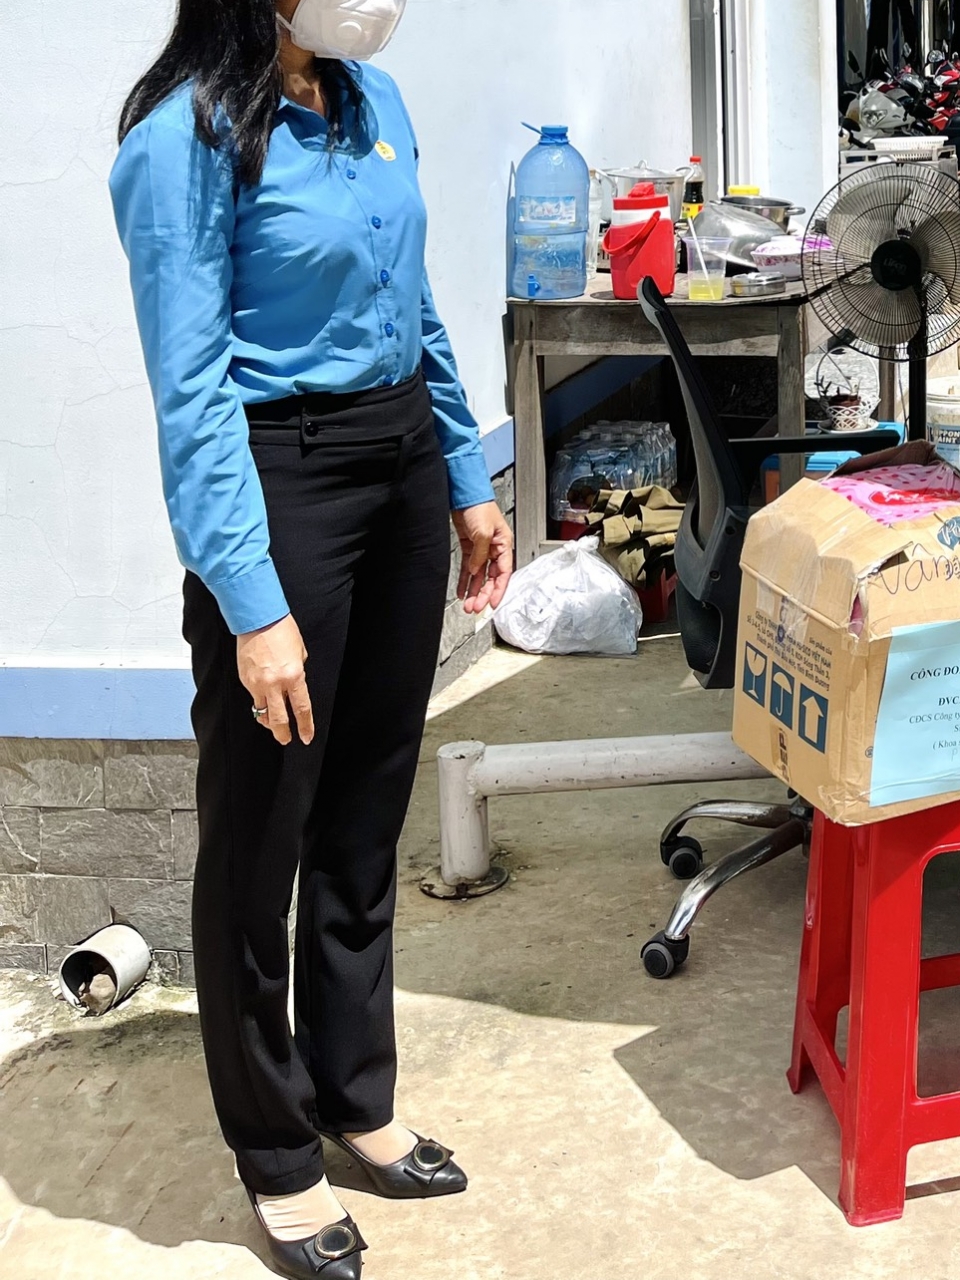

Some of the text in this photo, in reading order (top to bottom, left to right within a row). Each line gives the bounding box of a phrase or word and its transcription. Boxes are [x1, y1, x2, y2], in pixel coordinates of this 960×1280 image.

[910, 667, 942, 681] CÔNG
[933, 711, 953, 722] Công
[938, 738, 957, 749] Khoa
